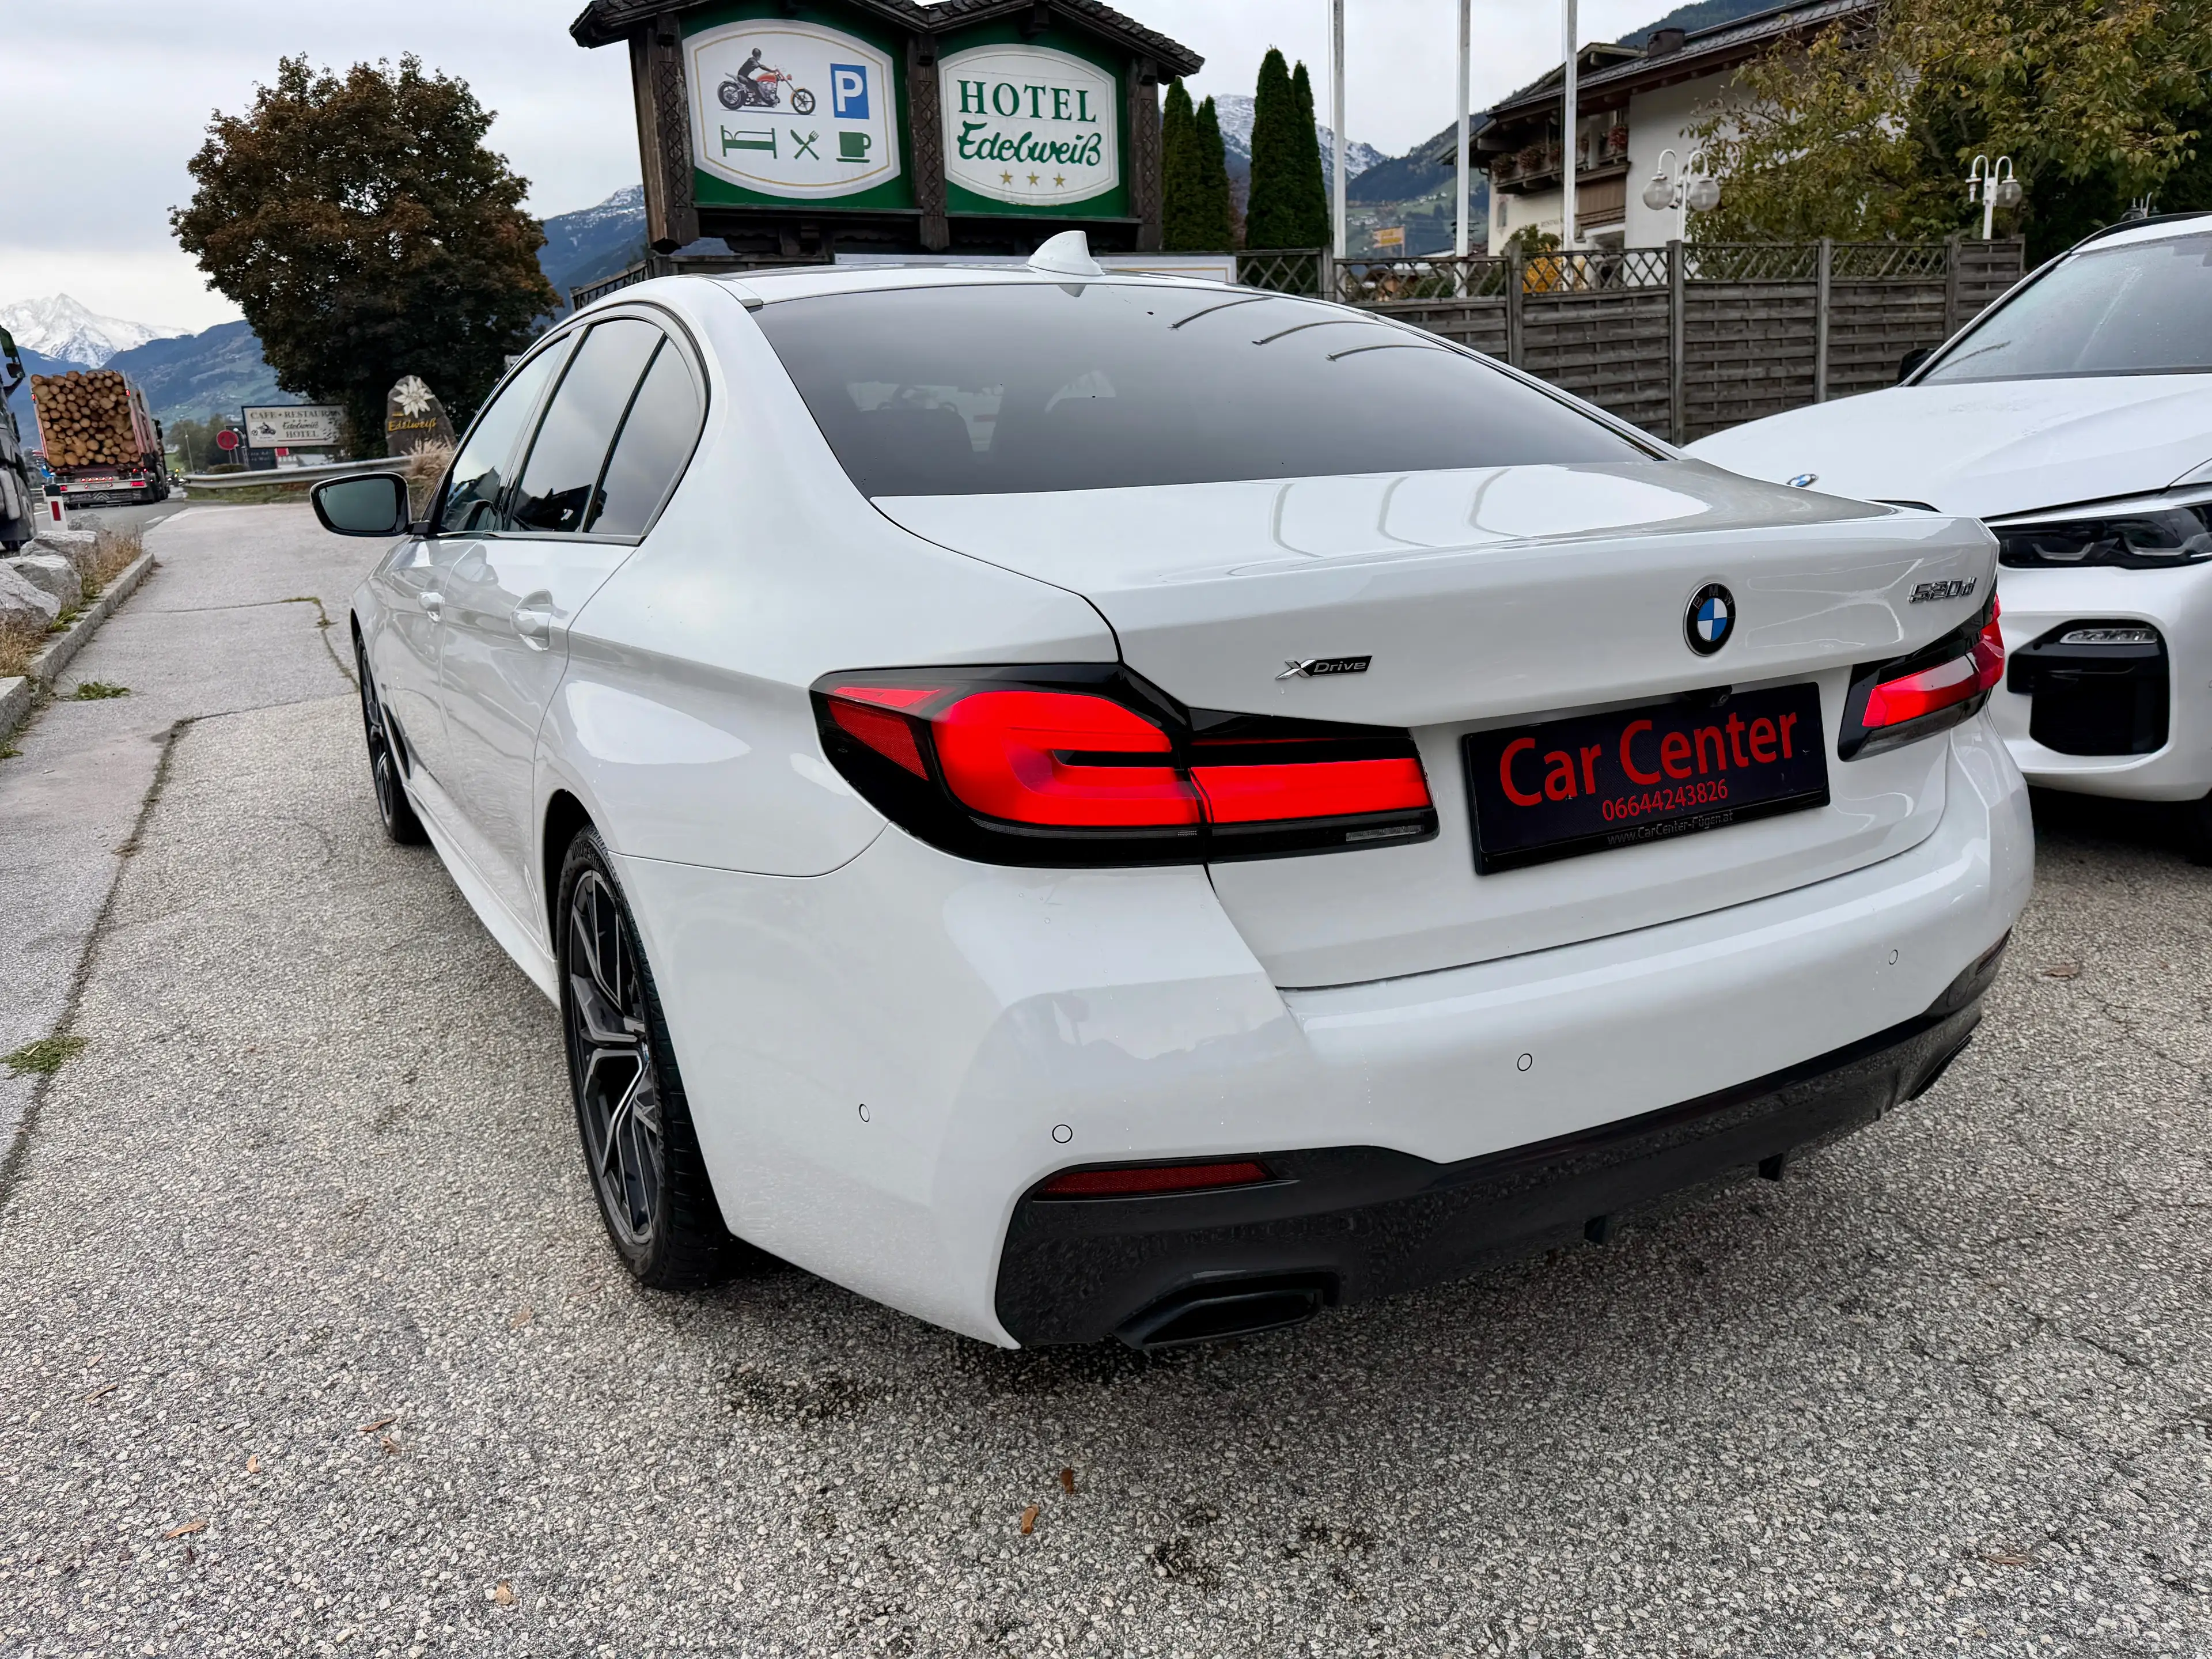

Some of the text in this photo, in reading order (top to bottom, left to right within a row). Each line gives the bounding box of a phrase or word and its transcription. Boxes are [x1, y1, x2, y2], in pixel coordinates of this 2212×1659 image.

[838, 70, 864, 112] P
[958, 79, 1097, 123] HOTEL
[957, 121, 1101, 166] Edelweiß
[250, 411, 278, 419] CAFE
[388, 416, 437, 432] Edelweiß
[286, 430, 320, 438] HOTEL
[1692, 585, 1734, 609] BMW
[1907, 577, 1977, 604] 520d
[1499, 711, 1797, 807] Car Center
[1602, 778, 1729, 821] 06644243826
[1607, 810, 1733, 846] www.CarCenter-Fügen.at
